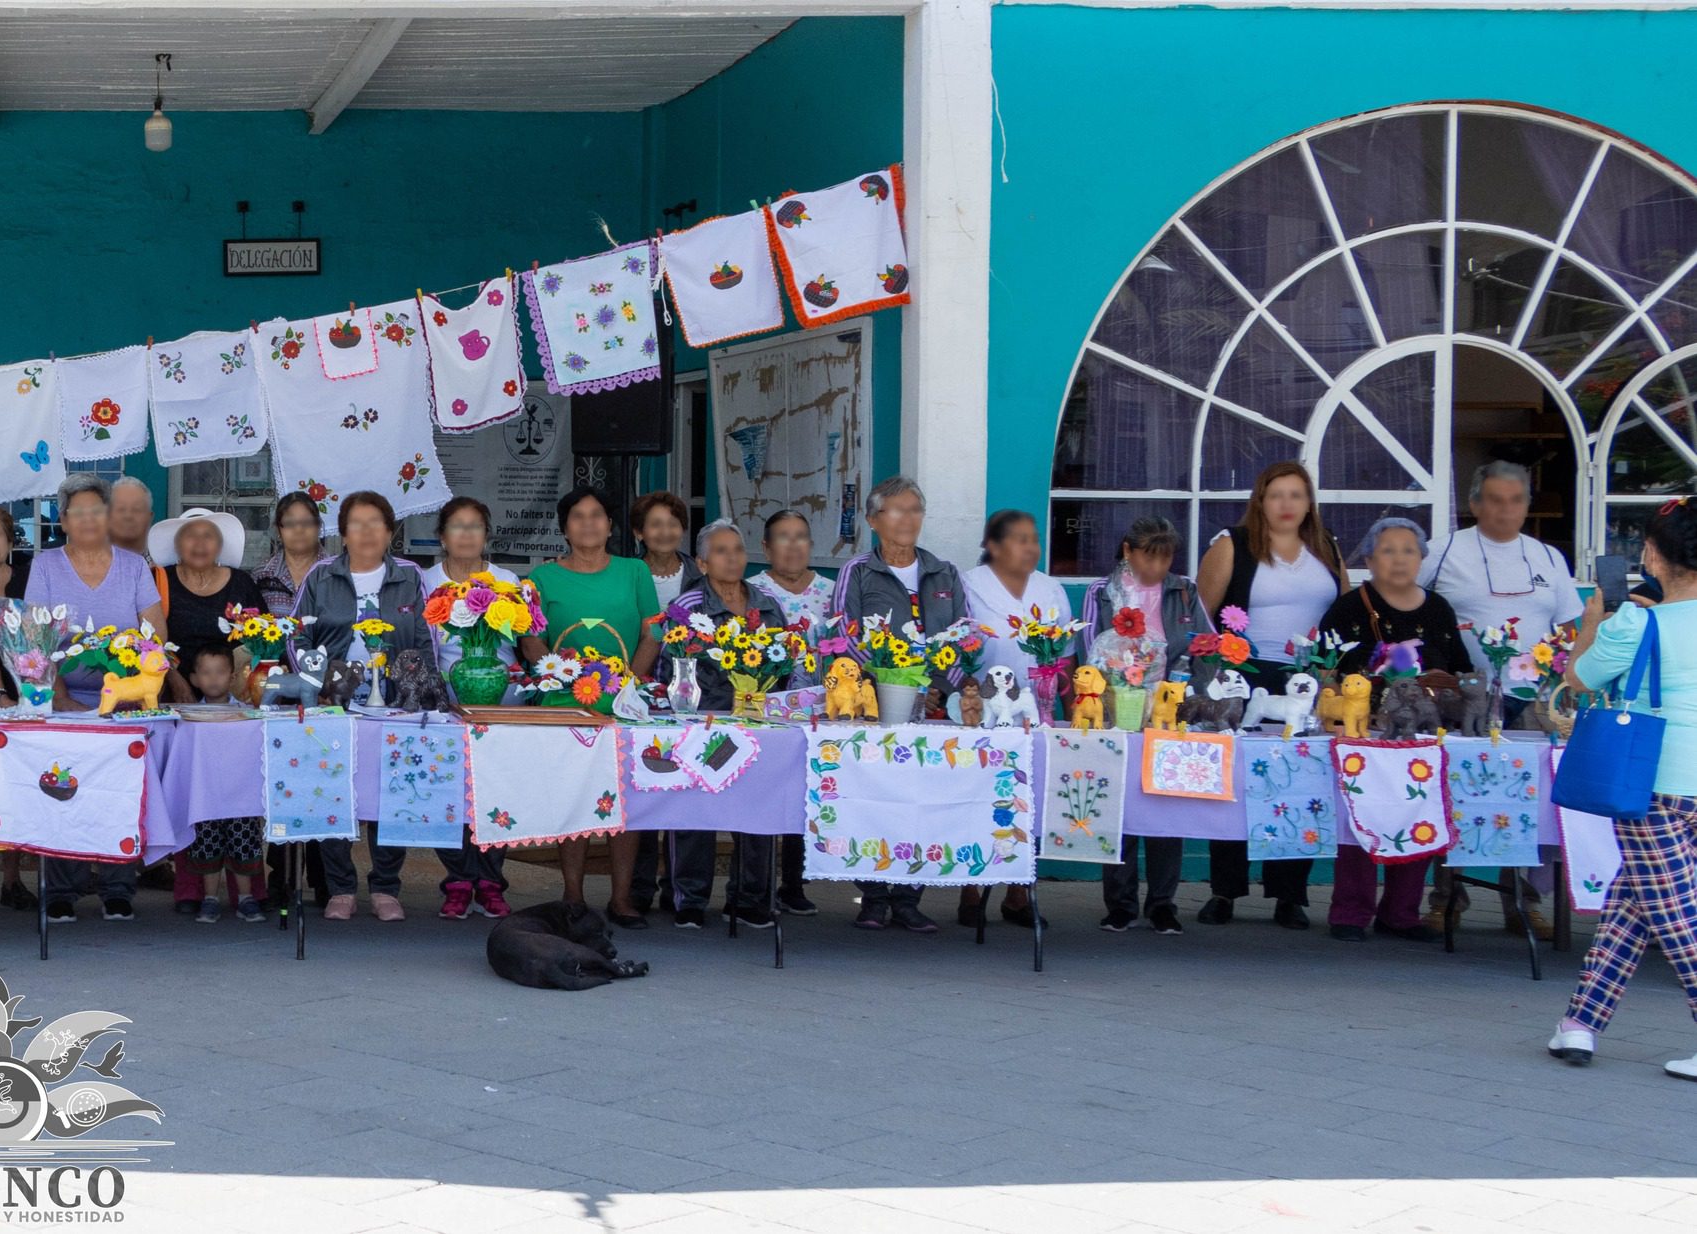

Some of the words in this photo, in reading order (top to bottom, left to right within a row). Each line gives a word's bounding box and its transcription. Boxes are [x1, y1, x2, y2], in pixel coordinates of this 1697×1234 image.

[229, 245, 314, 269] DELEGACIÓN
[505, 509, 519, 520] No
[520, 509, 544, 520] faltes
[546, 510, 555, 520] tu
[496, 525, 551, 537] Participación
